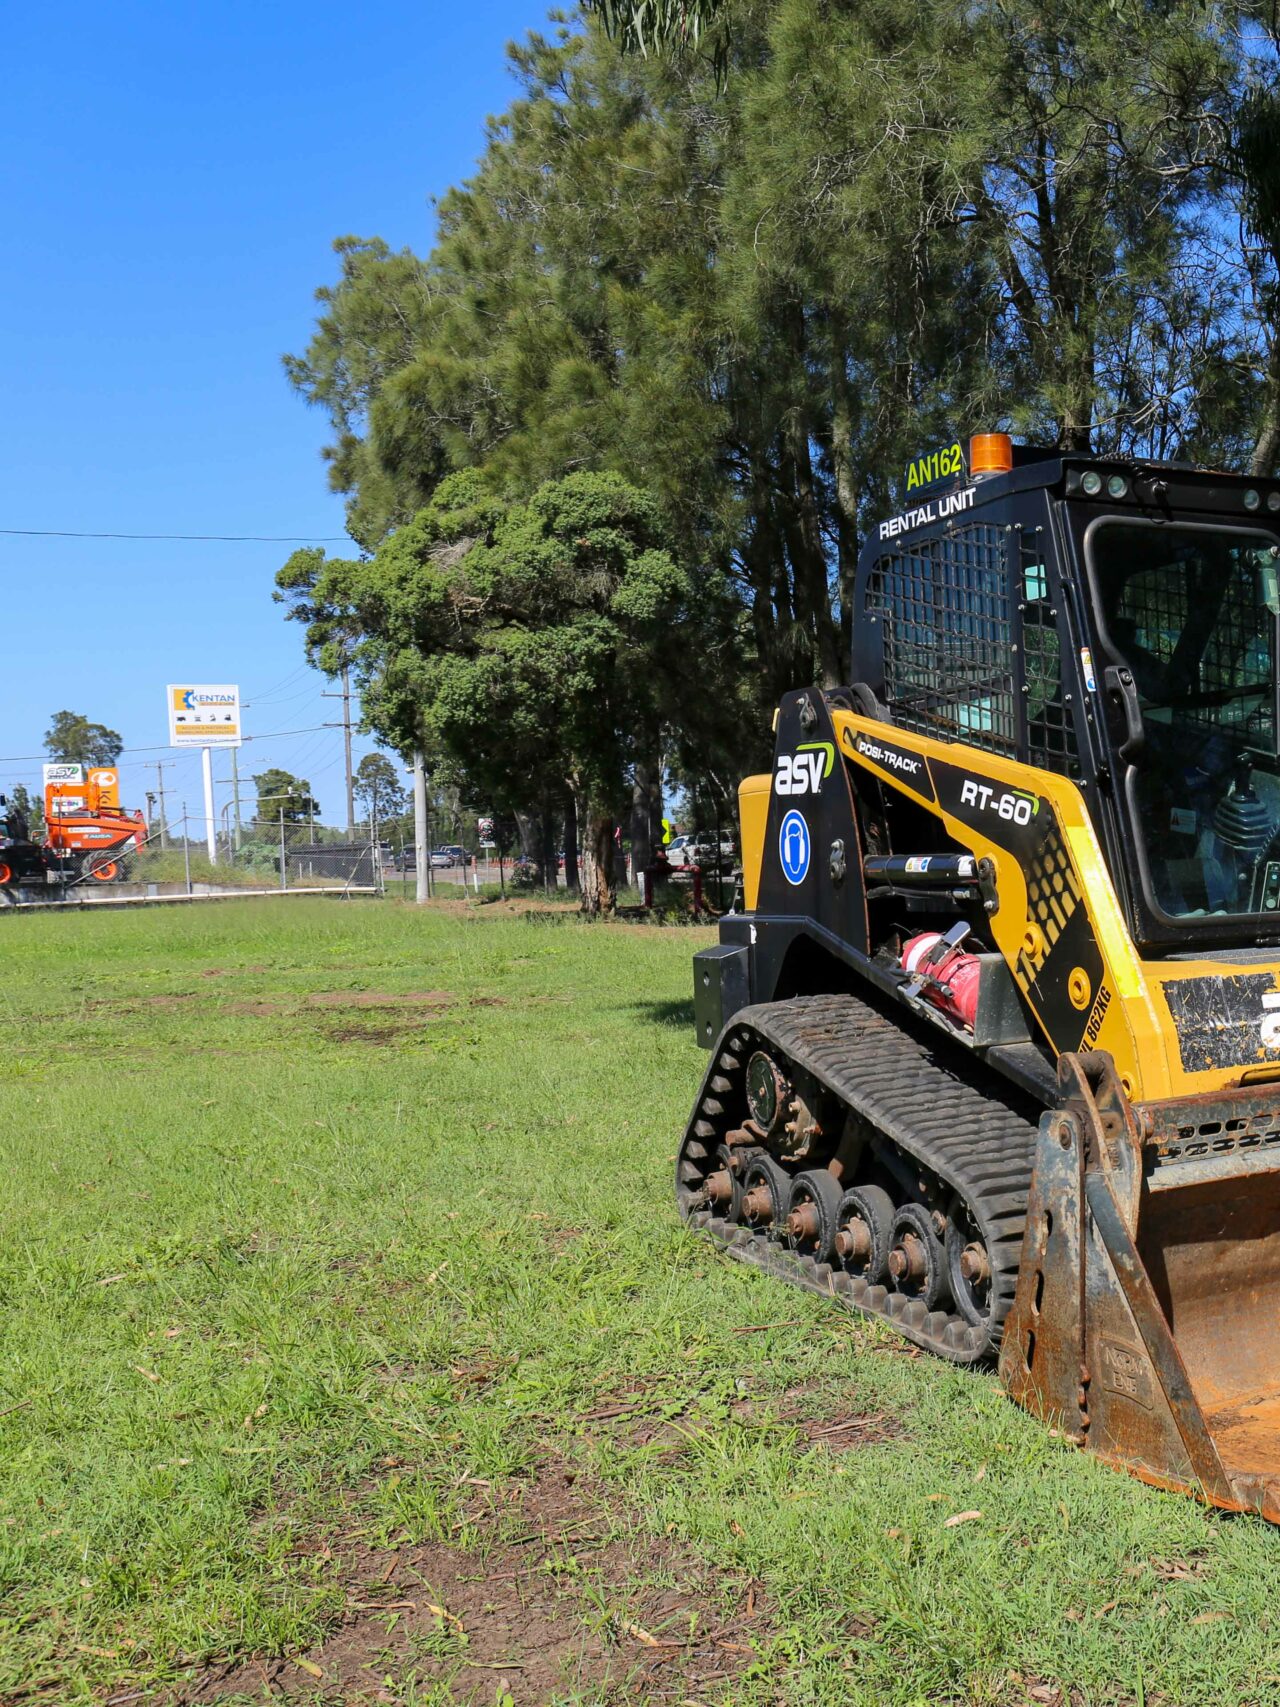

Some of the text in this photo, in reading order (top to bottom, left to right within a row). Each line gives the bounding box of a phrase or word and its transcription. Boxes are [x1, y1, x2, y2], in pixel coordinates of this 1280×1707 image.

[907, 444, 961, 491] AN162
[880, 487, 976, 540] RENTAL UNIT
[859, 741, 918, 774] POSI-TRACK
[960, 779, 1031, 825] RT-60
[1087, 985, 1112, 1042] 862KG
